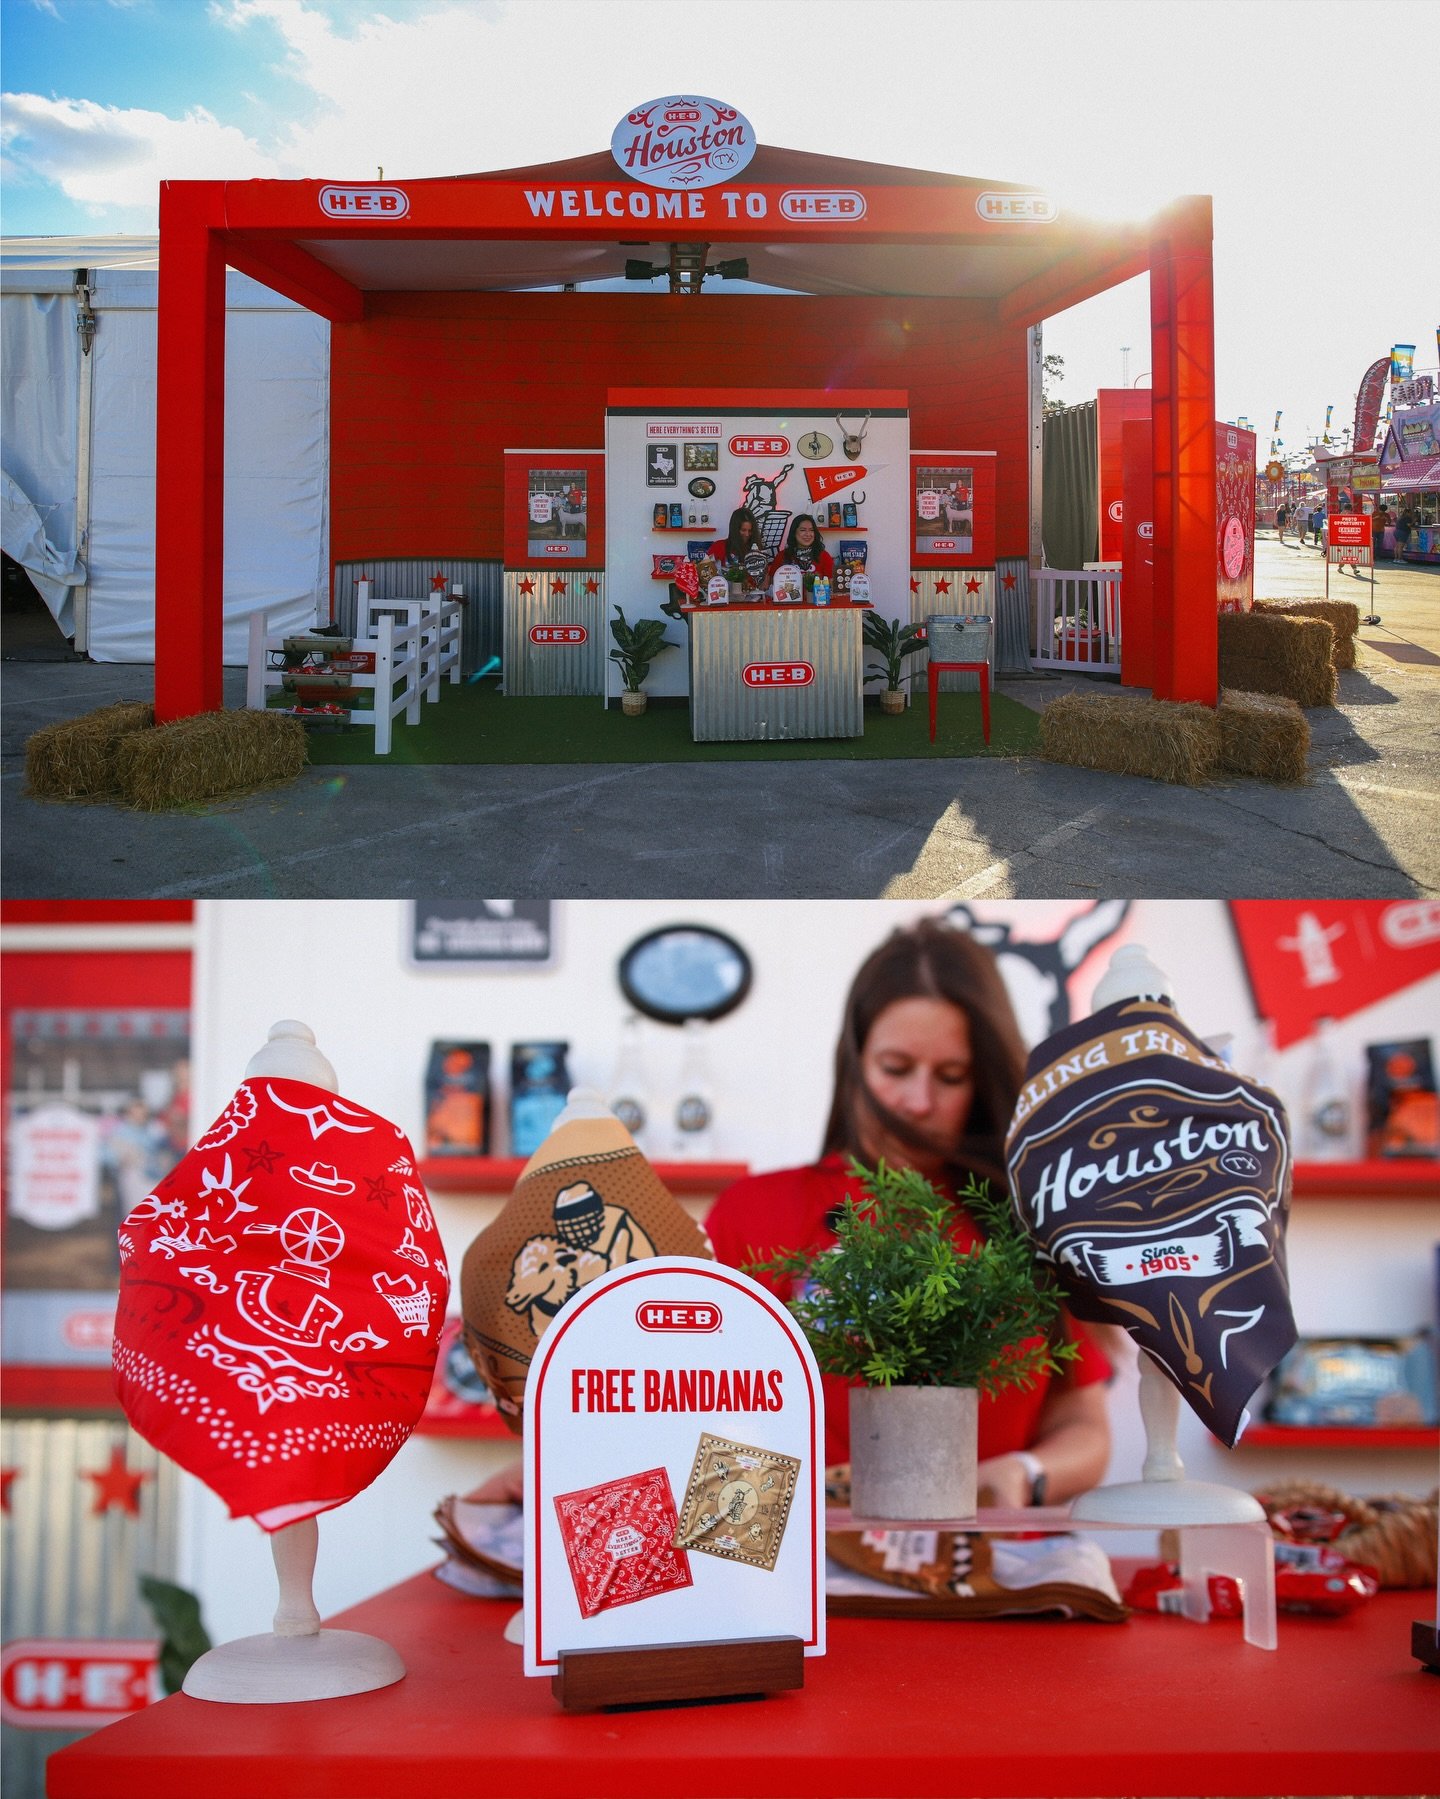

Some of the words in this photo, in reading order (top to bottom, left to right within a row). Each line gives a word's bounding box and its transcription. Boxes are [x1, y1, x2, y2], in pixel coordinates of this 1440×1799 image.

[668, 112, 697, 120] H-E-B
[624, 124, 746, 168] Houston
[714, 152, 735, 165] TX
[328, 194, 398, 212] H-E-B
[523, 190, 705, 219] WELCOME
[721, 192, 767, 219] TO
[789, 198, 857, 214] H-E-B
[985, 199, 1050, 216] H-E-B
[649, 426, 662, 434] HERE
[664, 426, 699, 434] EVERYTHING'S
[700, 426, 719, 434] BETTER
[735, 440, 784, 453] H-E-B
[536, 629, 581, 642] H-E-B
[751, 668, 807, 682] H-E-B
[1121, 1029, 1190, 1061] THE
[1225, 1155, 1256, 1171] TX
[1031, 1116, 1269, 1229] Houston
[1141, 1244, 1187, 1265] Since
[1140, 1256, 1192, 1276] 1905
[647, 1310, 712, 1324] H-E-B
[571, 1369, 636, 1413] FREE
[644, 1368, 783, 1413] BANDANAS
